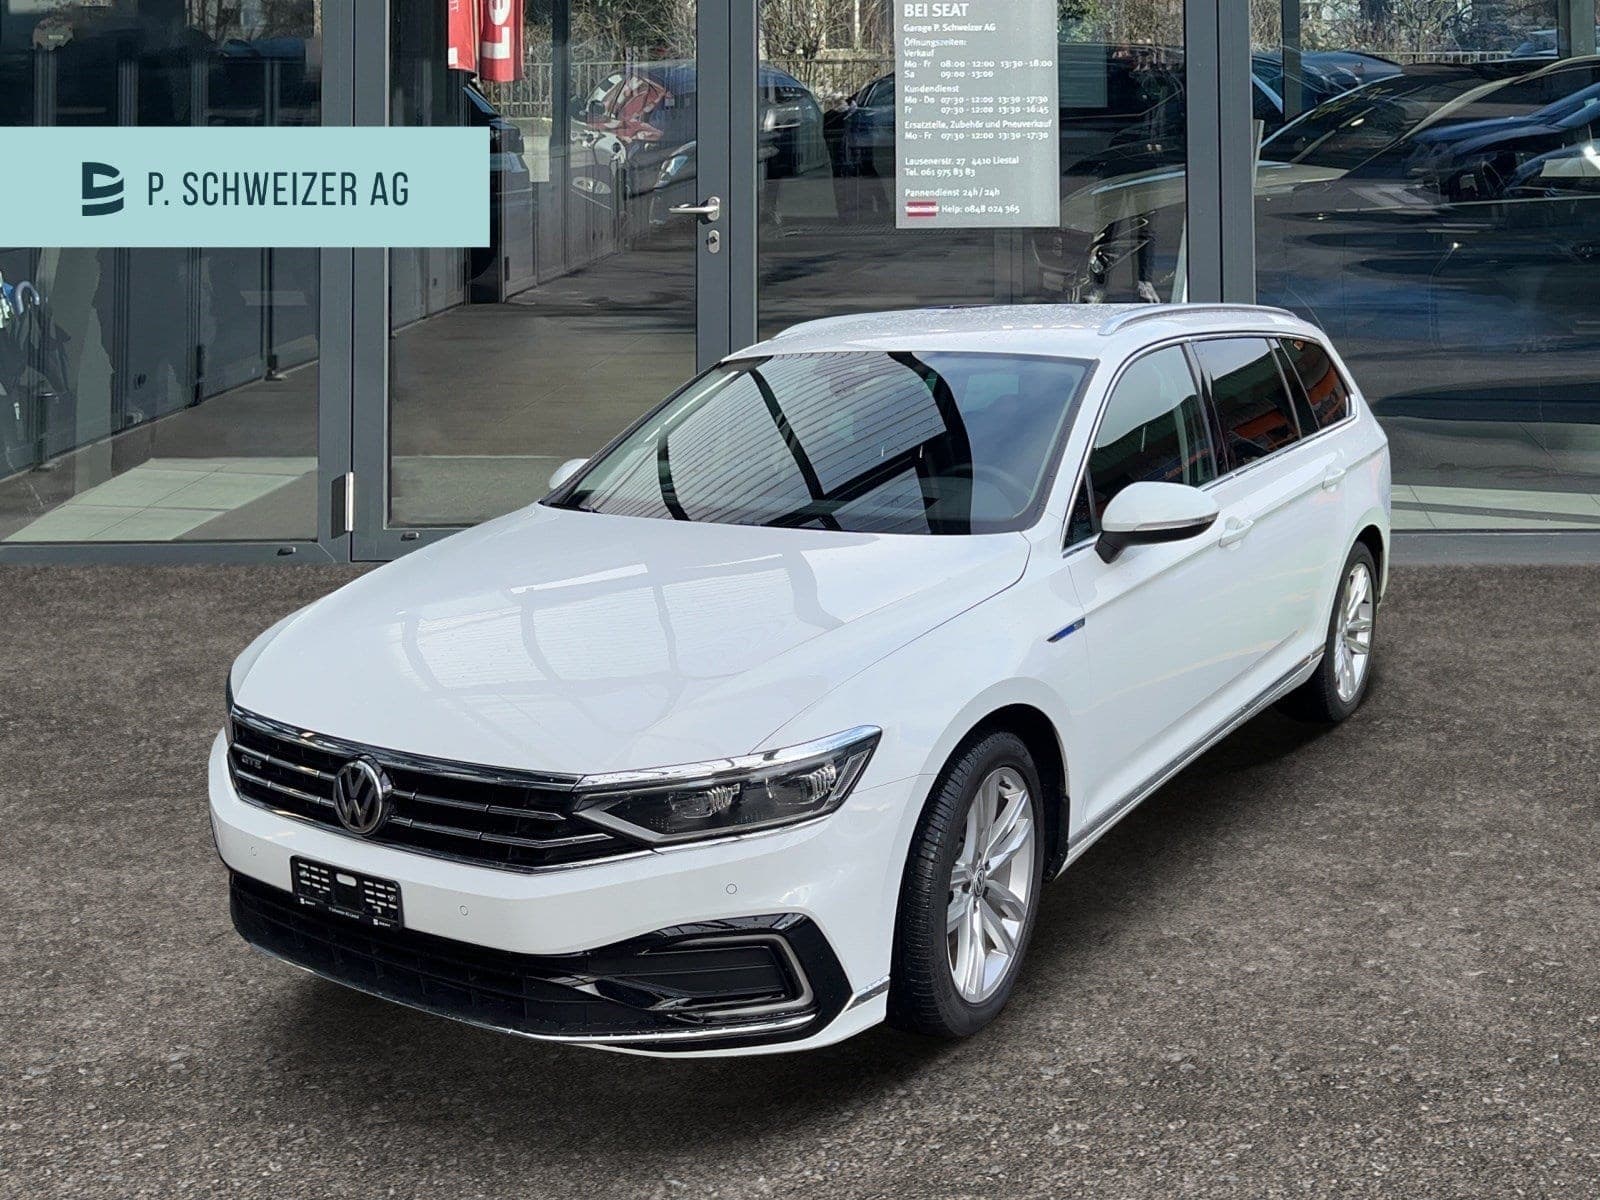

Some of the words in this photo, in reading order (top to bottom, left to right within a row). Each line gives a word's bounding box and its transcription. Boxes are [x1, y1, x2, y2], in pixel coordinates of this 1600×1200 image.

[903, 3, 928, 17] BEI
[932, 3, 969, 17] SEAT
[903, 24, 932, 33] Garage
[934, 24, 941, 32] P.
[942, 23, 982, 32] Schweizer
[984, 23, 996, 32] AG
[904, 49, 935, 57] Verkauf
[904, 60, 917, 68] Mo
[923, 60, 931, 68] Fr
[972, 60, 995, 68] 12:00
[904, 70, 915, 78] Sa
[904, 85, 960, 93] Kundendienst
[904, 96, 917, 104] Mo
[923, 96, 935, 104] Do
[904, 121, 949, 129] Ersatzteile,
[950, 120, 984, 128] Zubehör
[985, 120, 1000, 128] und
[1002, 119, 1052, 128] Pneuverkauf
[904, 131, 918, 140] Mo
[924, 131, 932, 139] Fr
[905, 157, 954, 166] Lausenerstr.
[956, 158, 965, 167] 27
[971, 157, 991, 166] 4410
[993, 155, 1019, 165] Liestal
[905, 168, 919, 177] Tel.
[920, 168, 935, 176] 061
[937, 168, 951, 177] 975
[953, 167, 963, 177] 83
[965, 167, 976, 177] 83
[905, 188, 960, 197] Pannendienst
[962, 187, 978, 198] 24h
[984, 187, 1000, 198] 24h
[941, 205, 962, 214] Help:
[964, 204, 986, 214] 0848
[1005, 204, 1020, 214] 365
